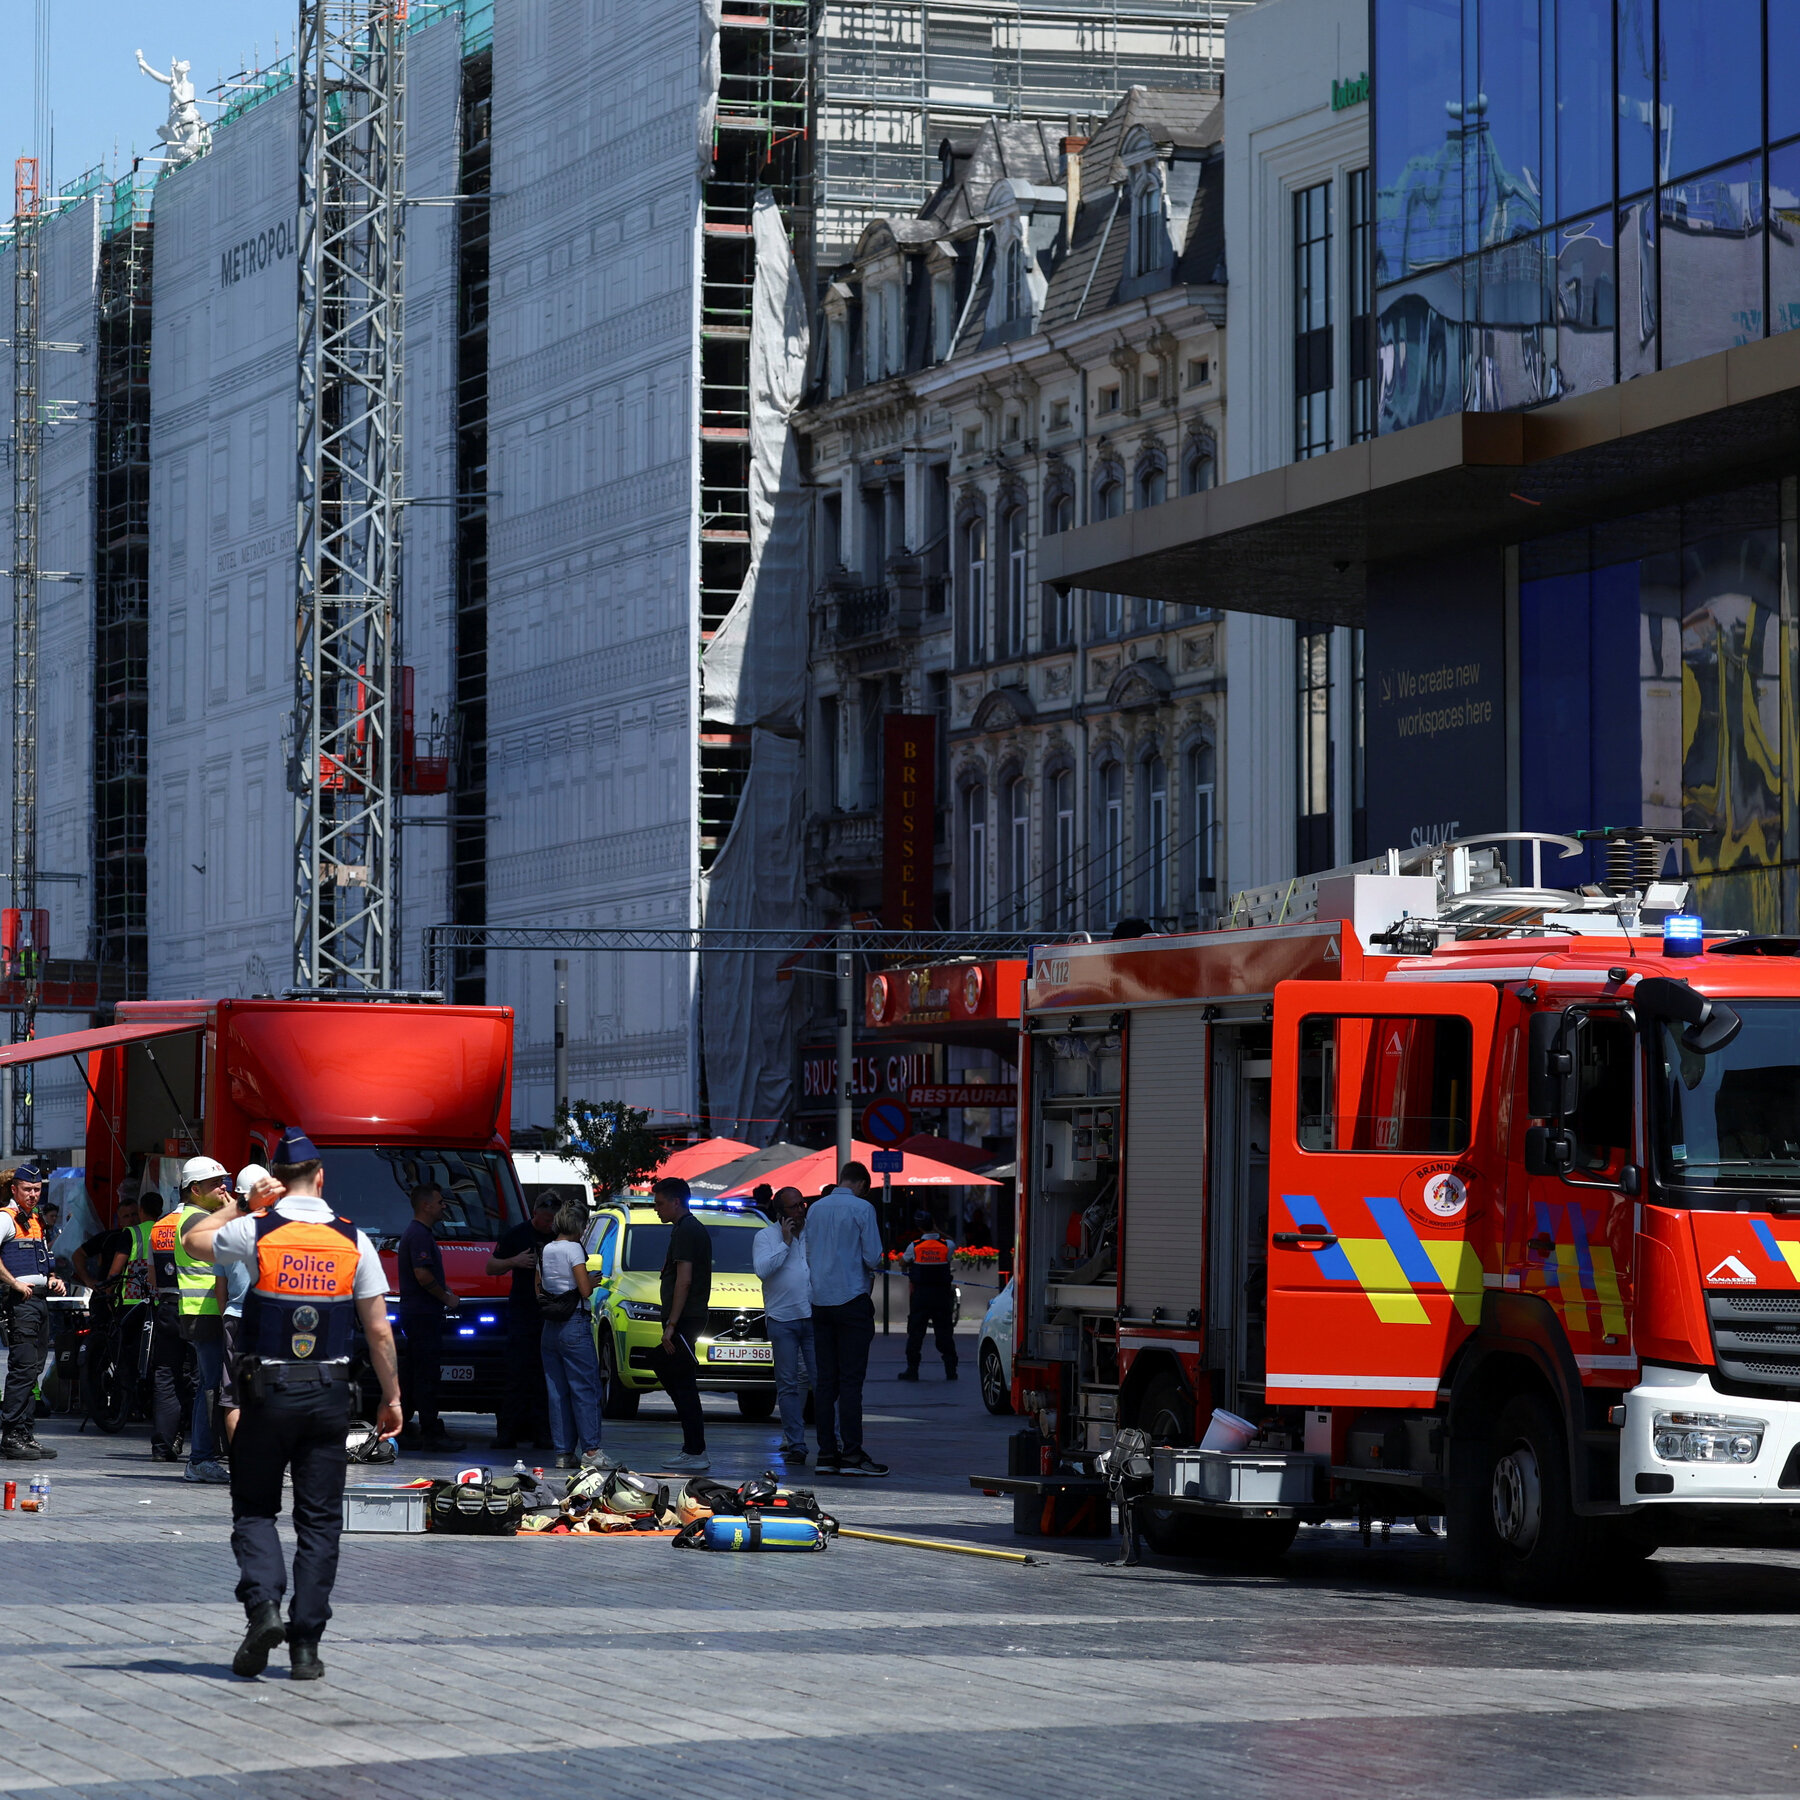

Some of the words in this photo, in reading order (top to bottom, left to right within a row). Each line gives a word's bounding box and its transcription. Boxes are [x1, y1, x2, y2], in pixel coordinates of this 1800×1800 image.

[222, 215, 299, 288] METROPOL
[217, 551, 237, 573] HOTEL
[241, 536, 276, 564] METROPOLE
[280, 528, 296, 551] HOTE
[1397, 670, 1416, 698] We
[1418, 664, 1454, 695] create
[1456, 663, 1480, 687] new
[1397, 706, 1464, 739] workspaces
[1466, 697, 1492, 725] here
[901, 741, 917, 930] BRUSSELS
[803, 1056, 878, 1096] BRUSELS
[910, 1088, 1018, 1103] RESTAURAN
[157, 1238, 174, 1248] Polit
[158, 1228, 176, 1239] Polic
[283, 1255, 335, 1273] Police
[277, 1273, 336, 1291] Politie
